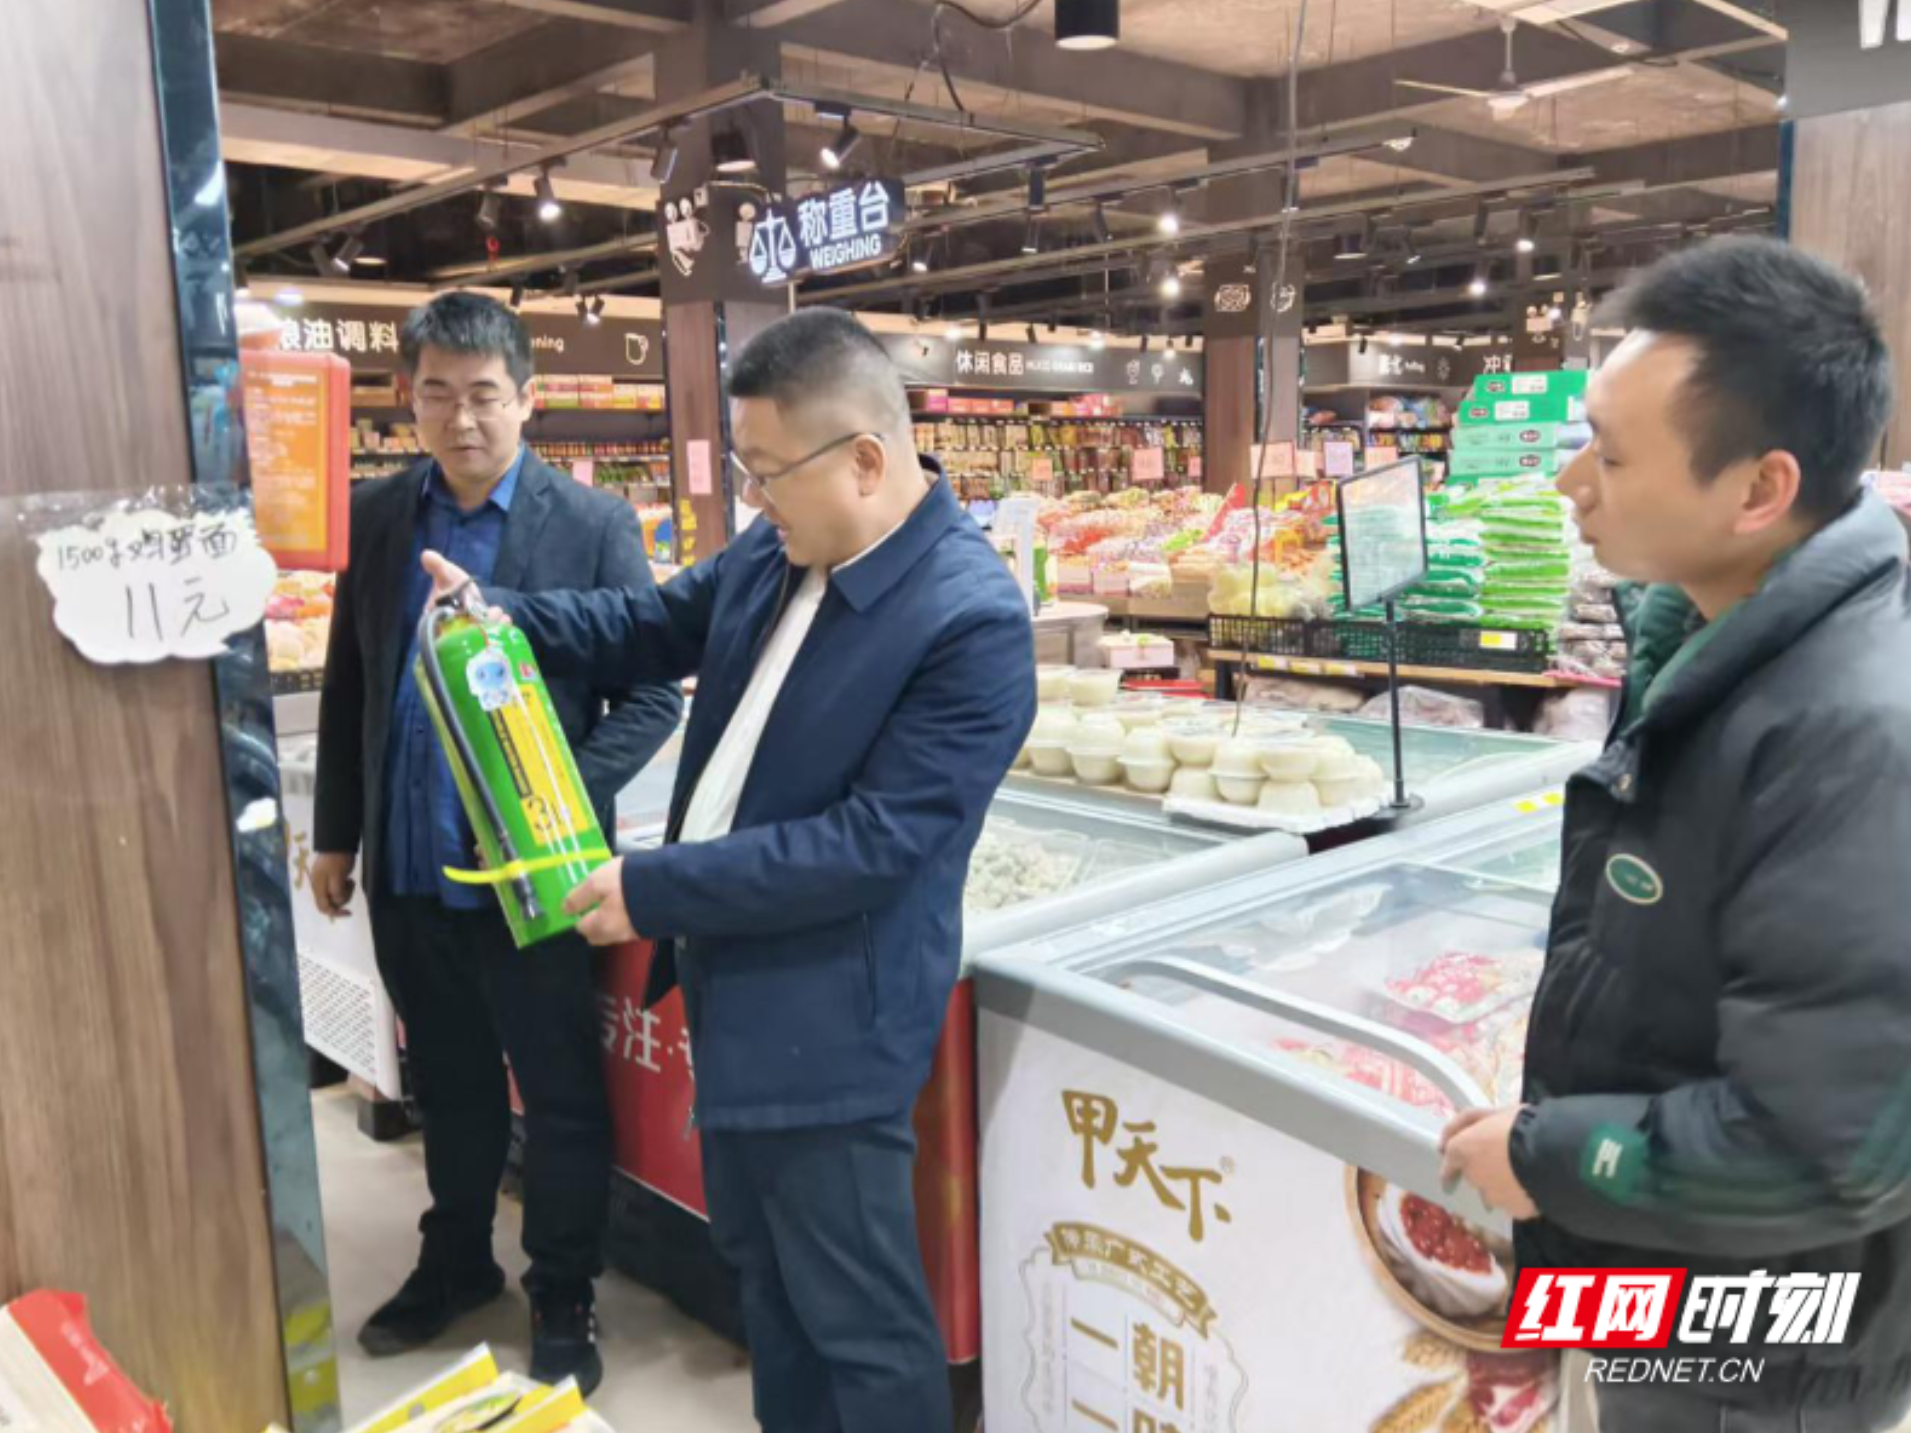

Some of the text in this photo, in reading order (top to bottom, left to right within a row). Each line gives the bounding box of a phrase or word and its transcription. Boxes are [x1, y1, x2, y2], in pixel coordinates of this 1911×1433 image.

[797, 179, 890, 248] 称重台
[810, 232, 882, 270] WEIGHING
[955, 350, 1025, 376] 休闲食品
[124, 576, 231, 642] 11元
[1061, 1088, 1233, 1243] 甲天下
